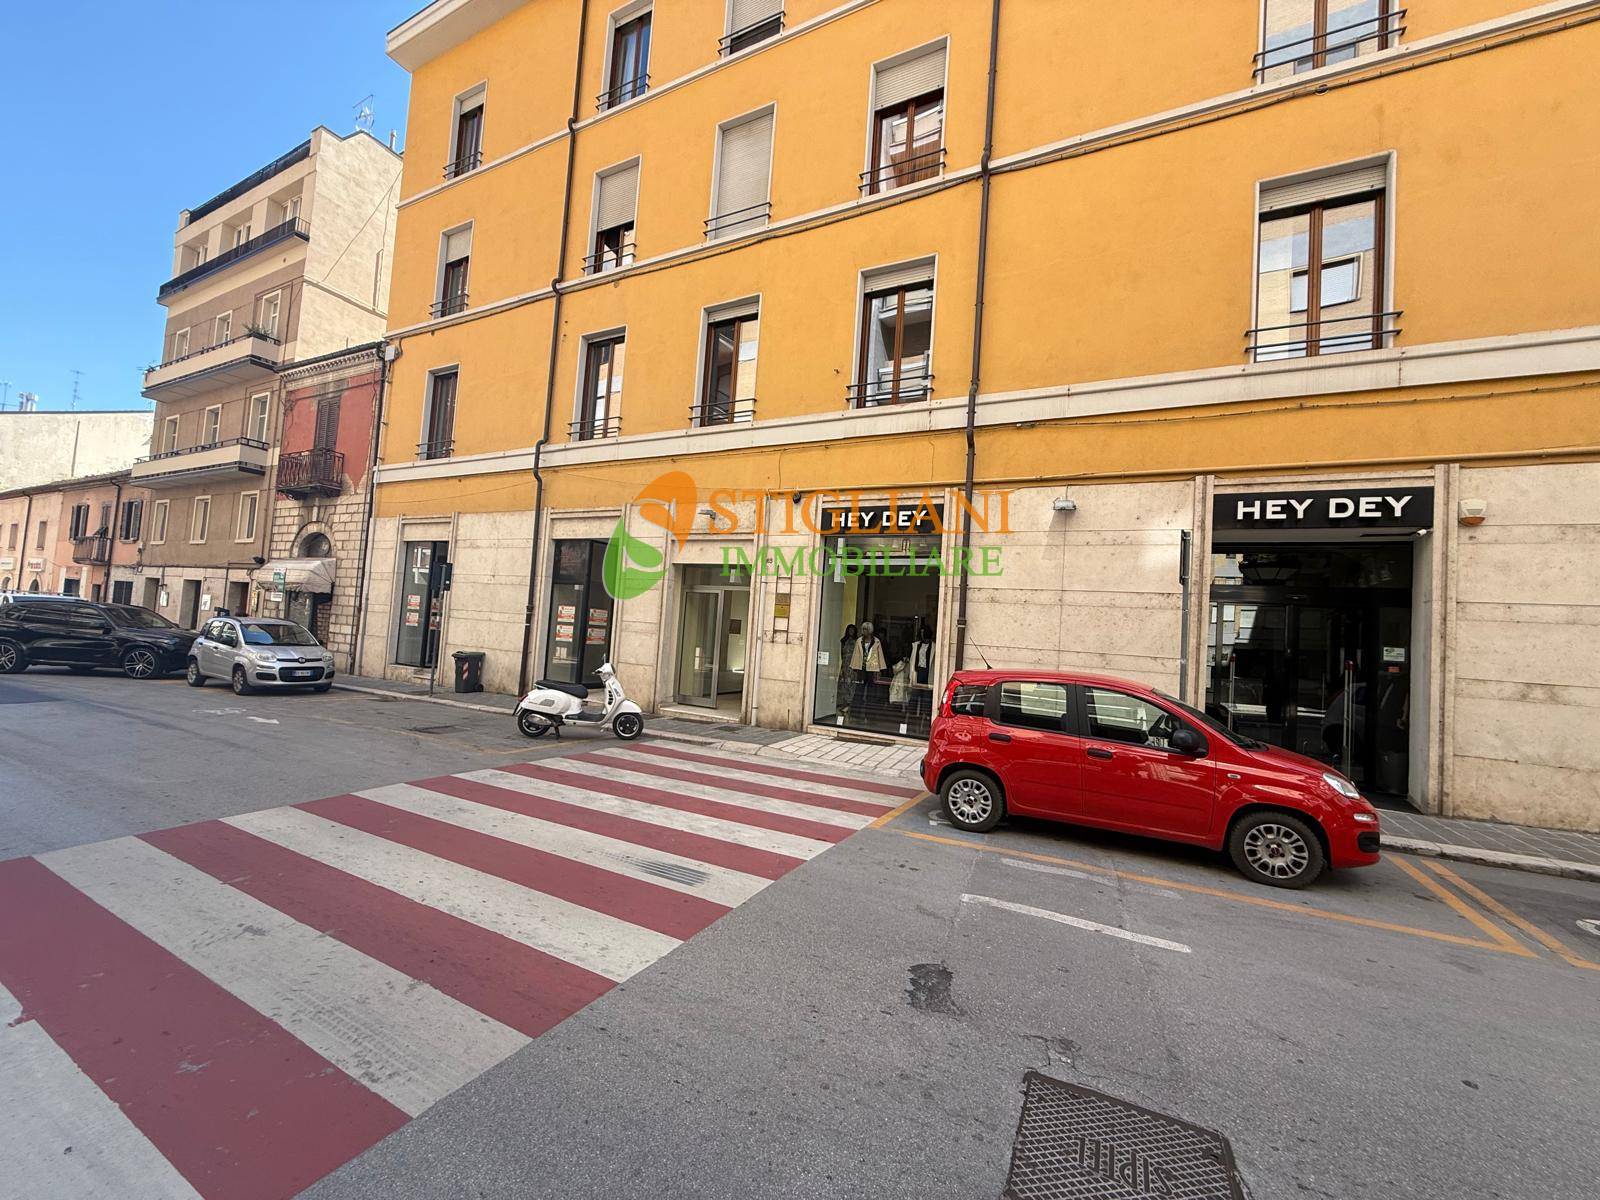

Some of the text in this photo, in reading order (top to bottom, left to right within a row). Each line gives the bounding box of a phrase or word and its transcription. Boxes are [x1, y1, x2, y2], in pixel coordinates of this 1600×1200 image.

[1236, 495, 1413, 520] HEY DEY
[831, 510, 928, 528] HEY DEY
